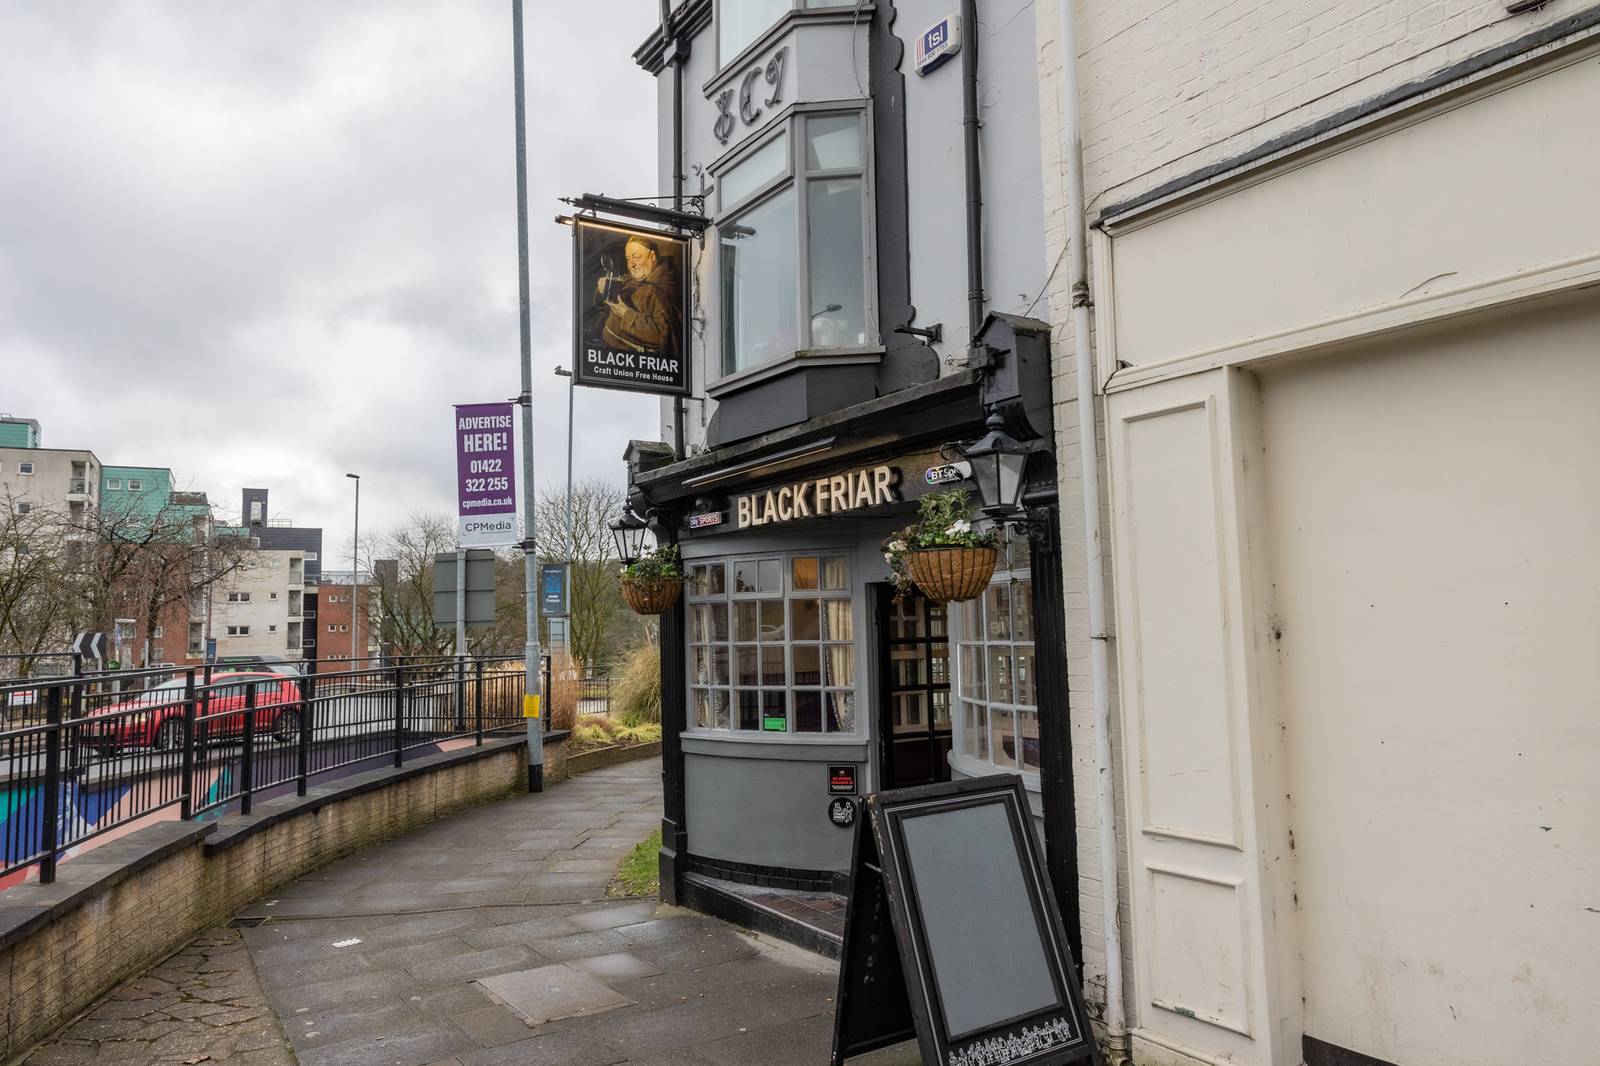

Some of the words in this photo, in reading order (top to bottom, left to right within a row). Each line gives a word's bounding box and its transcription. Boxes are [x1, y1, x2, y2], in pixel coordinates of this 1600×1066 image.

[588, 349, 634, 367] BLACK
[639, 356, 679, 373] FRIAR
[593, 365, 612, 376] Craft
[613, 368, 634, 378] Union
[635, 371, 651, 380] Free
[652, 374, 674, 383] House
[459, 415, 511, 430] ADVERTISE
[464, 433, 507, 452] HERE!
[470, 458, 502, 474] 01422
[931, 469, 943, 480] BT
[465, 478, 486, 492] 322
[487, 476, 509, 491] 255
[463, 497, 512, 509] cpmedia.co.uk
[737, 482, 810, 529] BLACK
[814, 465, 894, 515] FRIAR
[465, 521, 511, 532] CPMedia
